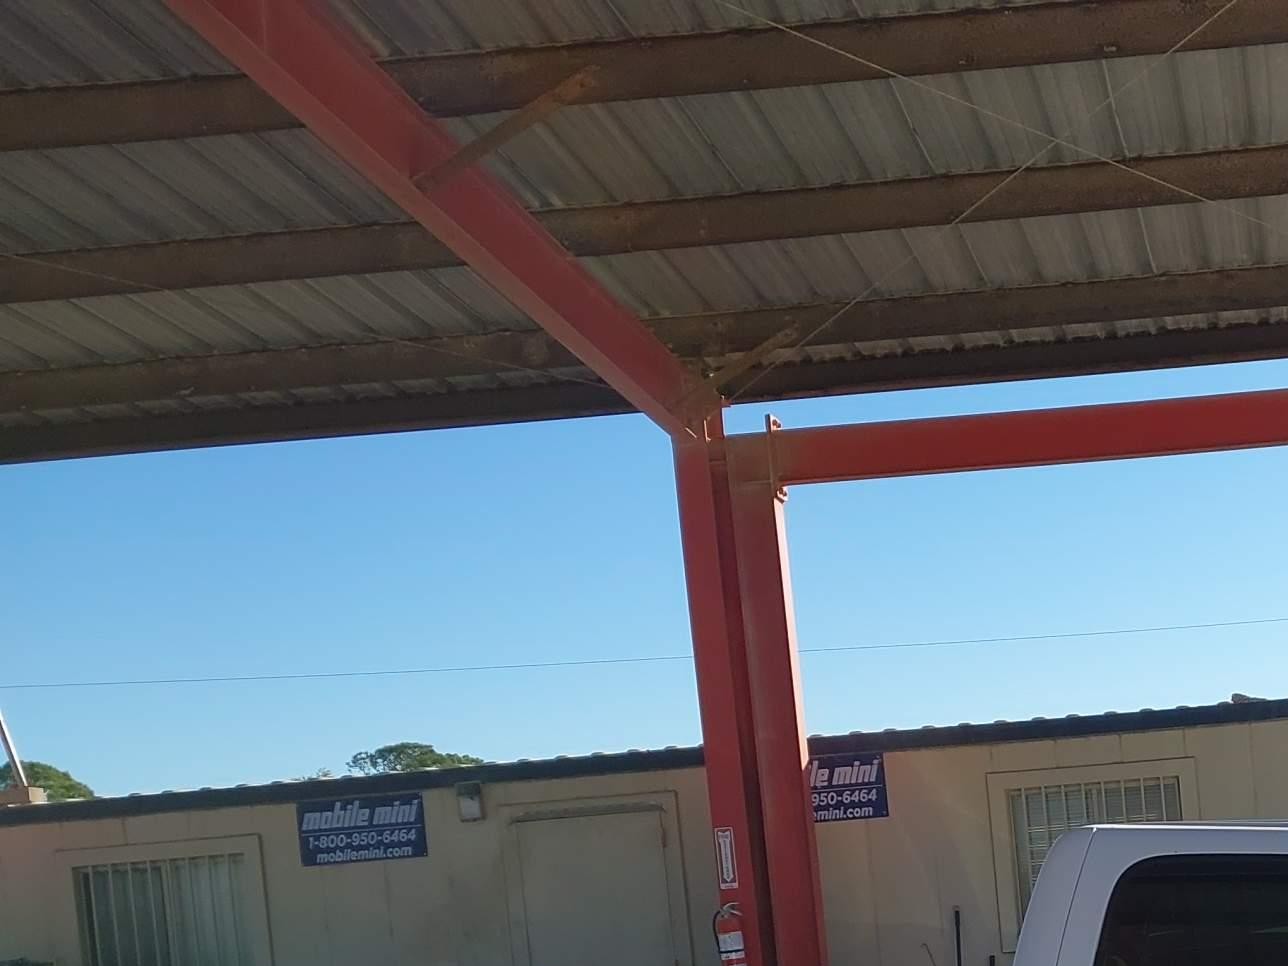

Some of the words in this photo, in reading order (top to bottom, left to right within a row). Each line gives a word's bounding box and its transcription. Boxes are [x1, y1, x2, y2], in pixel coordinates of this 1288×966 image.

[831, 758, 880, 785] mini
[811, 788, 878, 806] 950-6464
[302, 800, 370, 831] mobile
[372, 799, 418, 825] mini
[814, 806, 873, 821] mini.com
[308, 828, 416, 849] 1-800-950-6464
[316, 845, 412, 863] mobilemini.com
